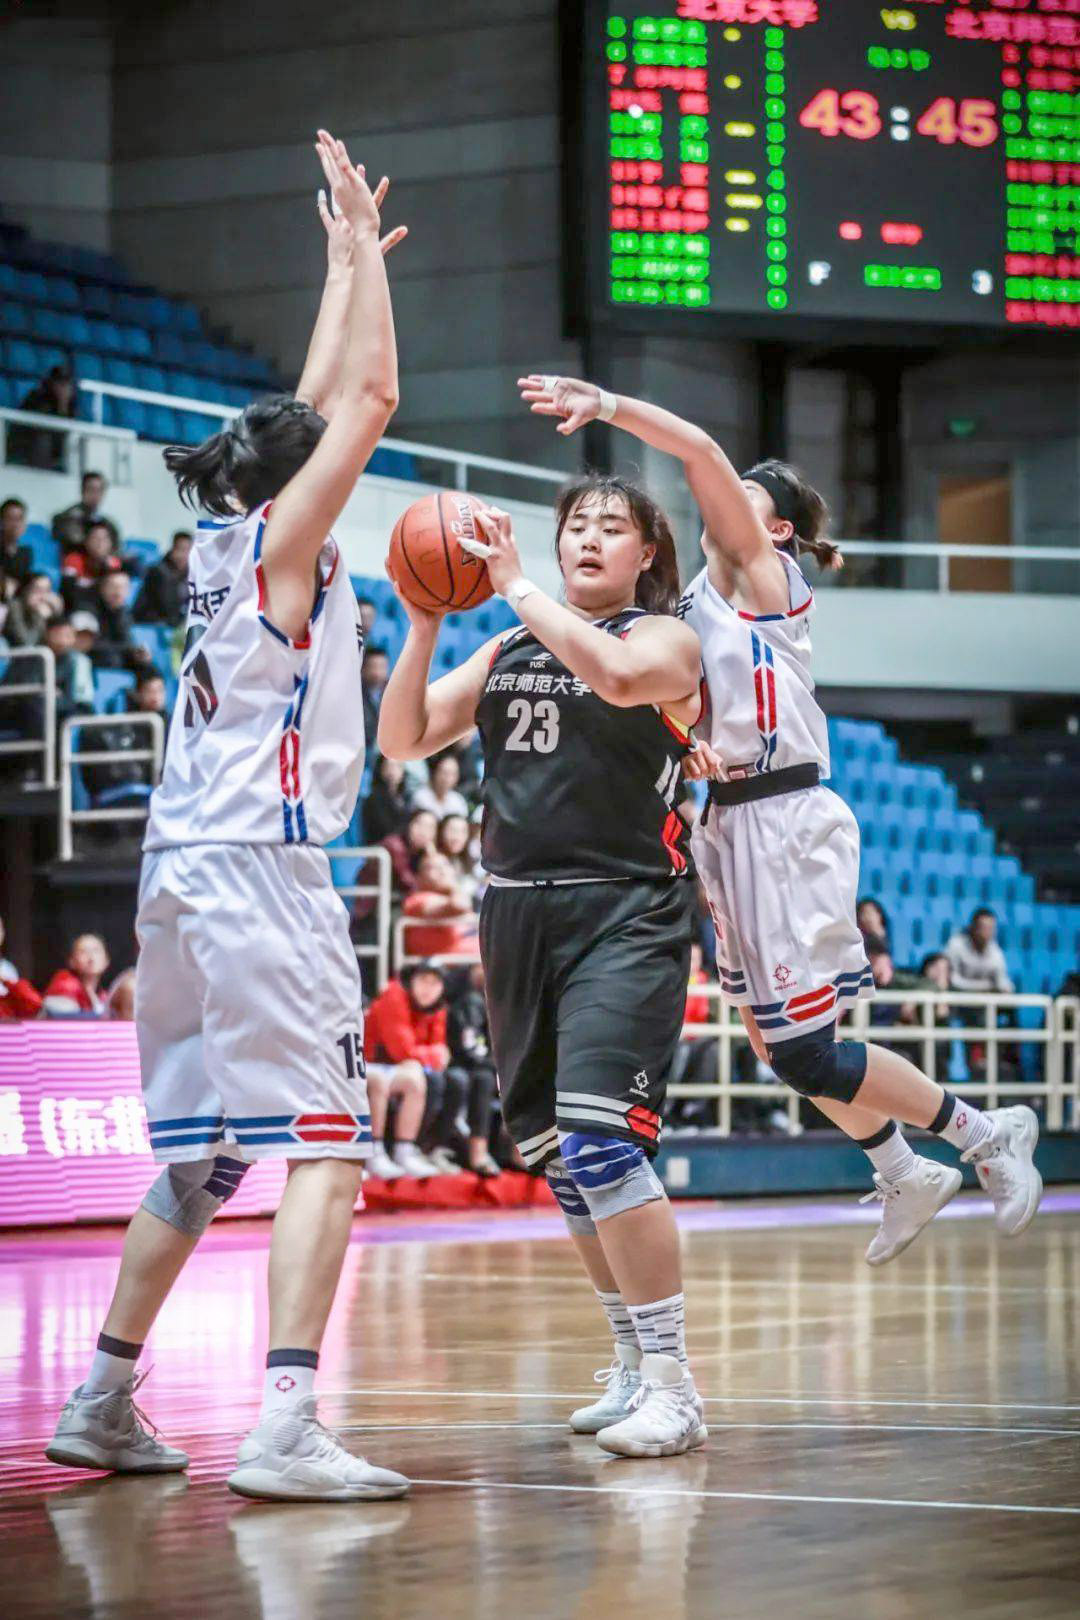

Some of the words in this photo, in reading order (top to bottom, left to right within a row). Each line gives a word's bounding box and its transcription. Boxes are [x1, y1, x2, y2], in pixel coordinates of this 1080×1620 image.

[799, 89, 882, 140] 43
[916, 97, 999, 147] 45
[485, 672, 592, 697] 北京师范大学
[505, 698, 560, 754] 23
[336, 1032, 367, 1079] 15
